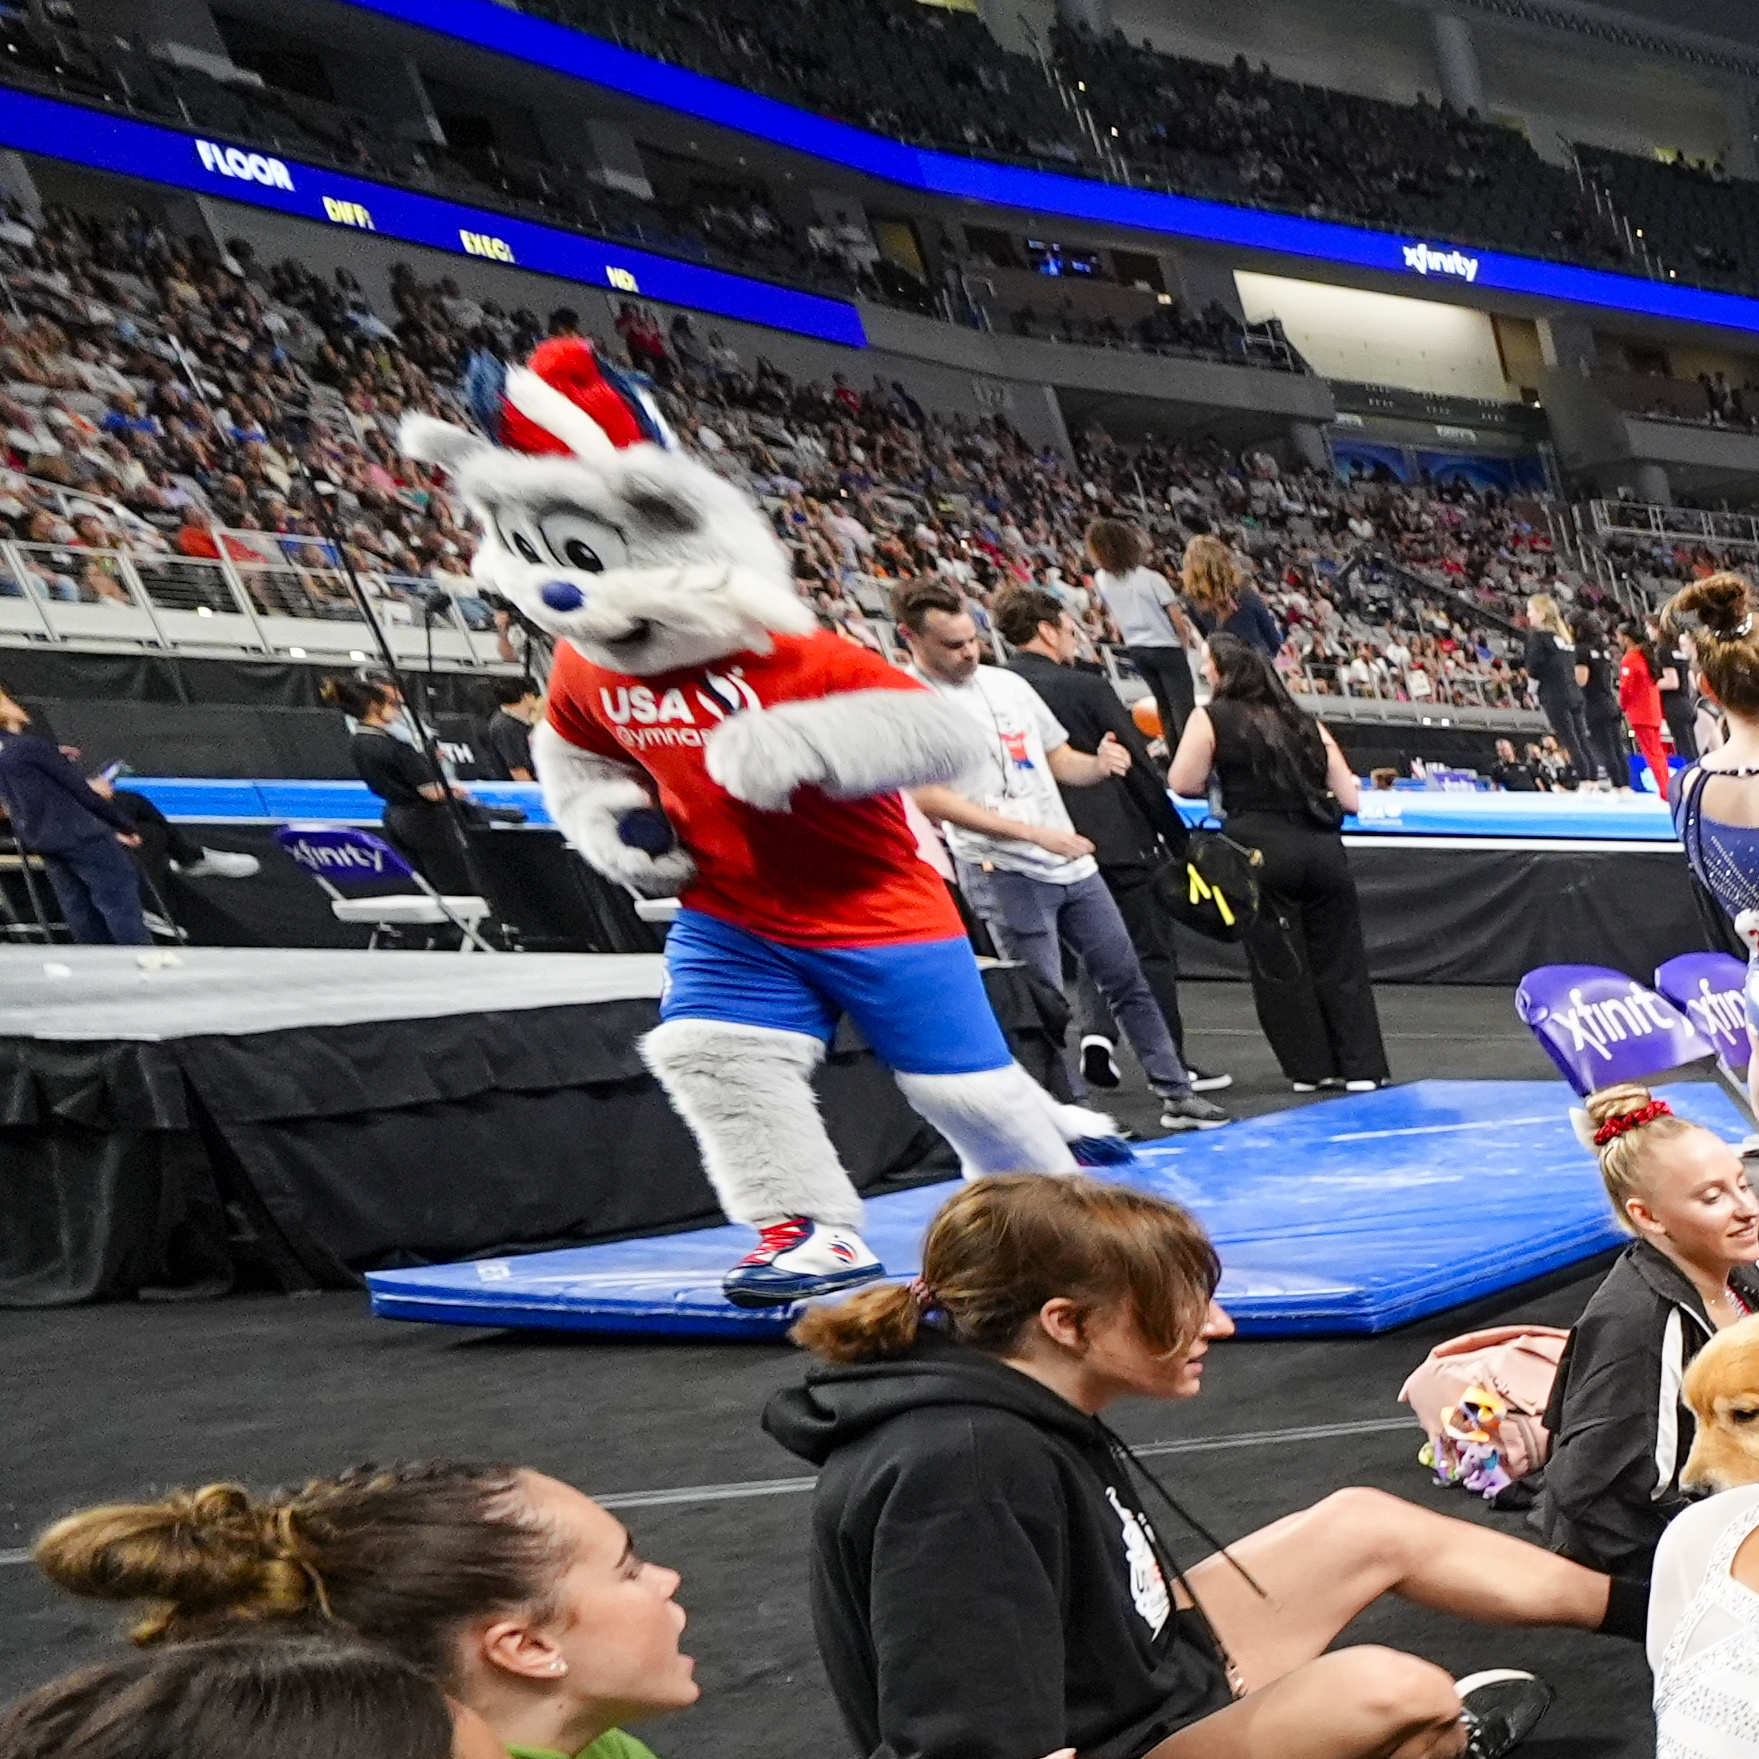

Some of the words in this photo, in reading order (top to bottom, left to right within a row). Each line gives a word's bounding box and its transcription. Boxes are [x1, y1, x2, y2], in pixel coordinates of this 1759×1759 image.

[195, 138, 297, 193] FLOOR
[1402, 243, 1478, 282] xfinity
[600, 686, 696, 724] USA
[616, 725, 718, 750] Gymna
[283, 839, 383, 873] xfinity
[1687, 978, 1744, 1045] xfin
